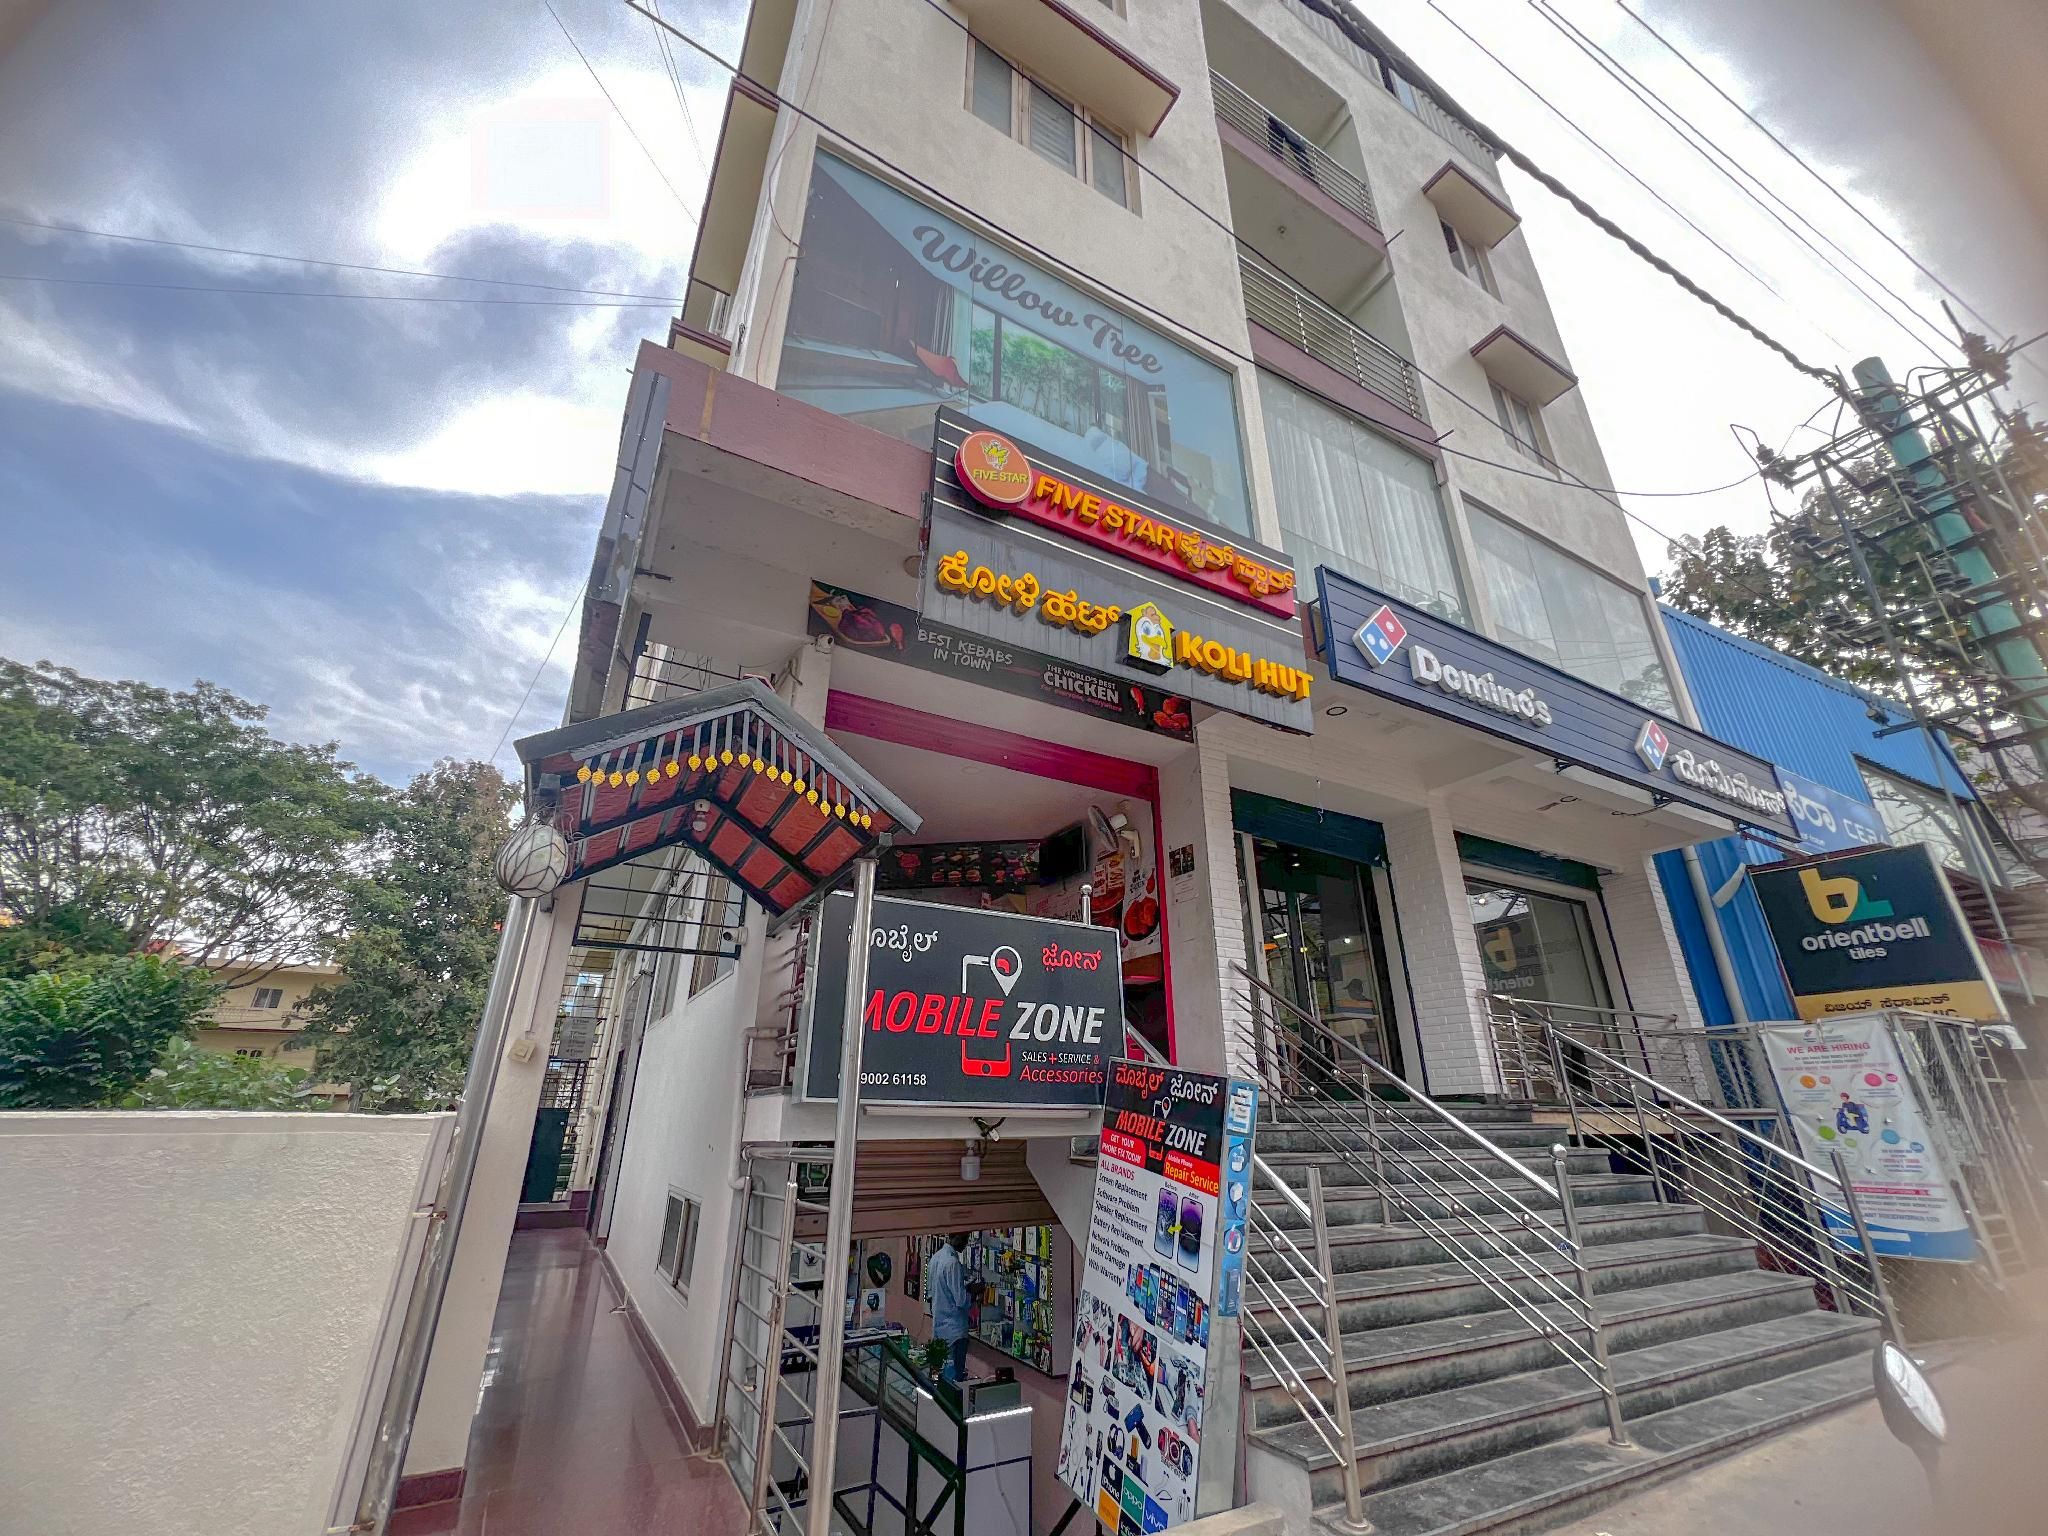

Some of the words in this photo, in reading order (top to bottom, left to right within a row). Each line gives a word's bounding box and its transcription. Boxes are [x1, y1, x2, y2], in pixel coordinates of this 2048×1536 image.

[912, 225, 1078, 327] Willow
[1084, 314, 1163, 374] Tree
[973, 470, 998, 481] FIVE
[999, 471, 1029, 484] STAR
[1036, 475, 1100, 518] FIVE
[1101, 505, 1176, 553] STAR
[938, 551, 1040, 612] ಕೋಳಿ
[1040, 589, 1121, 634] ಹಟ್
[917, 629, 952, 649] BEST
[957, 640, 1013, 665] KEBABS
[933, 647, 948, 661] IN
[952, 651, 991, 672] TOWN
[1046, 664, 1062, 674] THE
[1063, 668, 1098, 684] WORLD'S
[1099, 680, 1116, 690] BEST
[1176, 630, 1252, 679] KOLI
[1253, 657, 1313, 700] HUT
[1043, 671, 1119, 704] CHICKEN
[1409, 645, 1552, 727] Domino's
[1843, 818, 1885, 845] CER
[1802, 917, 1931, 951] orientbell
[1849, 946, 1888, 960] tiles
[1824, 1000, 1872, 1012] ವಿಜಯ್
[1009, 1001, 1105, 1044] ZONE
[1021, 1051, 1047, 1063] SALES
[1058, 1052, 1092, 1065] SERVICE
[1786, 1046, 1806, 1055] WE
[1807, 1044, 1830, 1053] ARE
[1831, 1042, 1872, 1052] HIRING
[892, 1073, 927, 1086] 61158
[1019, 1064, 1104, 1084] Accessories
[1110, 1133, 1119, 1144] GET
[1121, 1136, 1135, 1149] YOUR
[1115, 1109, 1166, 1143] MOBILE
[1165, 1123, 1207, 1157] ZONE
[1102, 1142, 1117, 1156] PHONE
[1125, 1149, 1142, 1164] TODAY
[1100, 1159, 1111, 1171] ALL
[1111, 1163, 1136, 1181] BRANDS
[1164, 1161, 1189, 1181] Repair
[1189, 1171, 1219, 1194] Service
[1114, 1180, 1148, 1201] Replacement
[1095, 1200, 1115, 1217] Speaker
[1114, 1209, 1148, 1232] Replacement
[1117, 1198, 1140, 1214] Problem
[1110, 1223, 1144, 1248] Replacement
[1104, 1250, 1126, 1270] Damage
[1110, 1240, 1130, 1259] Problem
